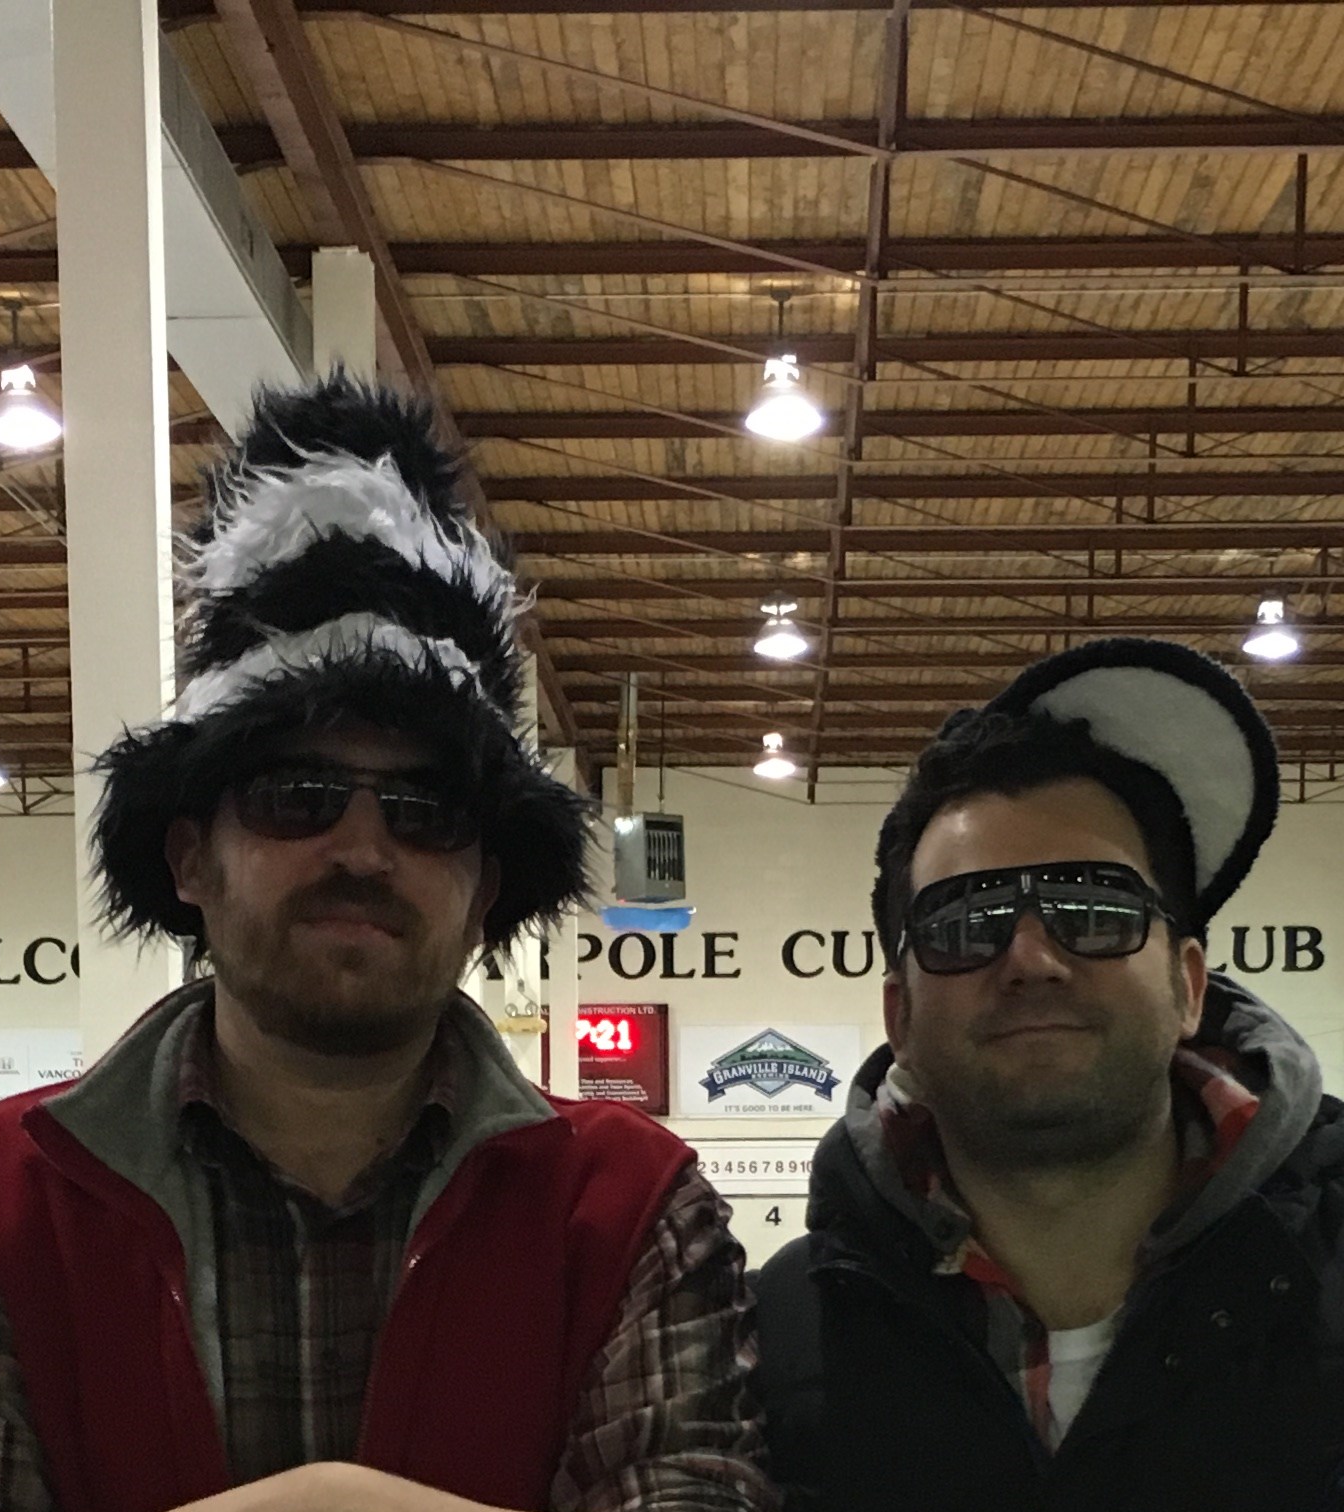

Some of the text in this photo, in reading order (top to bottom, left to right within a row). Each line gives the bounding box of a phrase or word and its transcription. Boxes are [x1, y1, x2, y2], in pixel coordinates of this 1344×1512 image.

[781, 930, 888, 978] CU
[1208, 926, 1324, 973] UB
[712, 1061, 828, 1084] GRANVILLE ISLAND
[742, 1104, 766, 1112] GOOD
[768, 1104, 779, 1112] TO
[781, 1104, 791, 1112] BE
[710, 1161, 720, 1174] 3
[724, 1161, 733, 1174] 4
[737, 1161, 746, 1174] 5
[749, 1161, 758, 1174] 6
[762, 1161, 771, 1173] 7
[775, 1160, 784, 1173] 8
[788, 1160, 798, 1173] 9
[764, 1205, 782, 1226] 4
